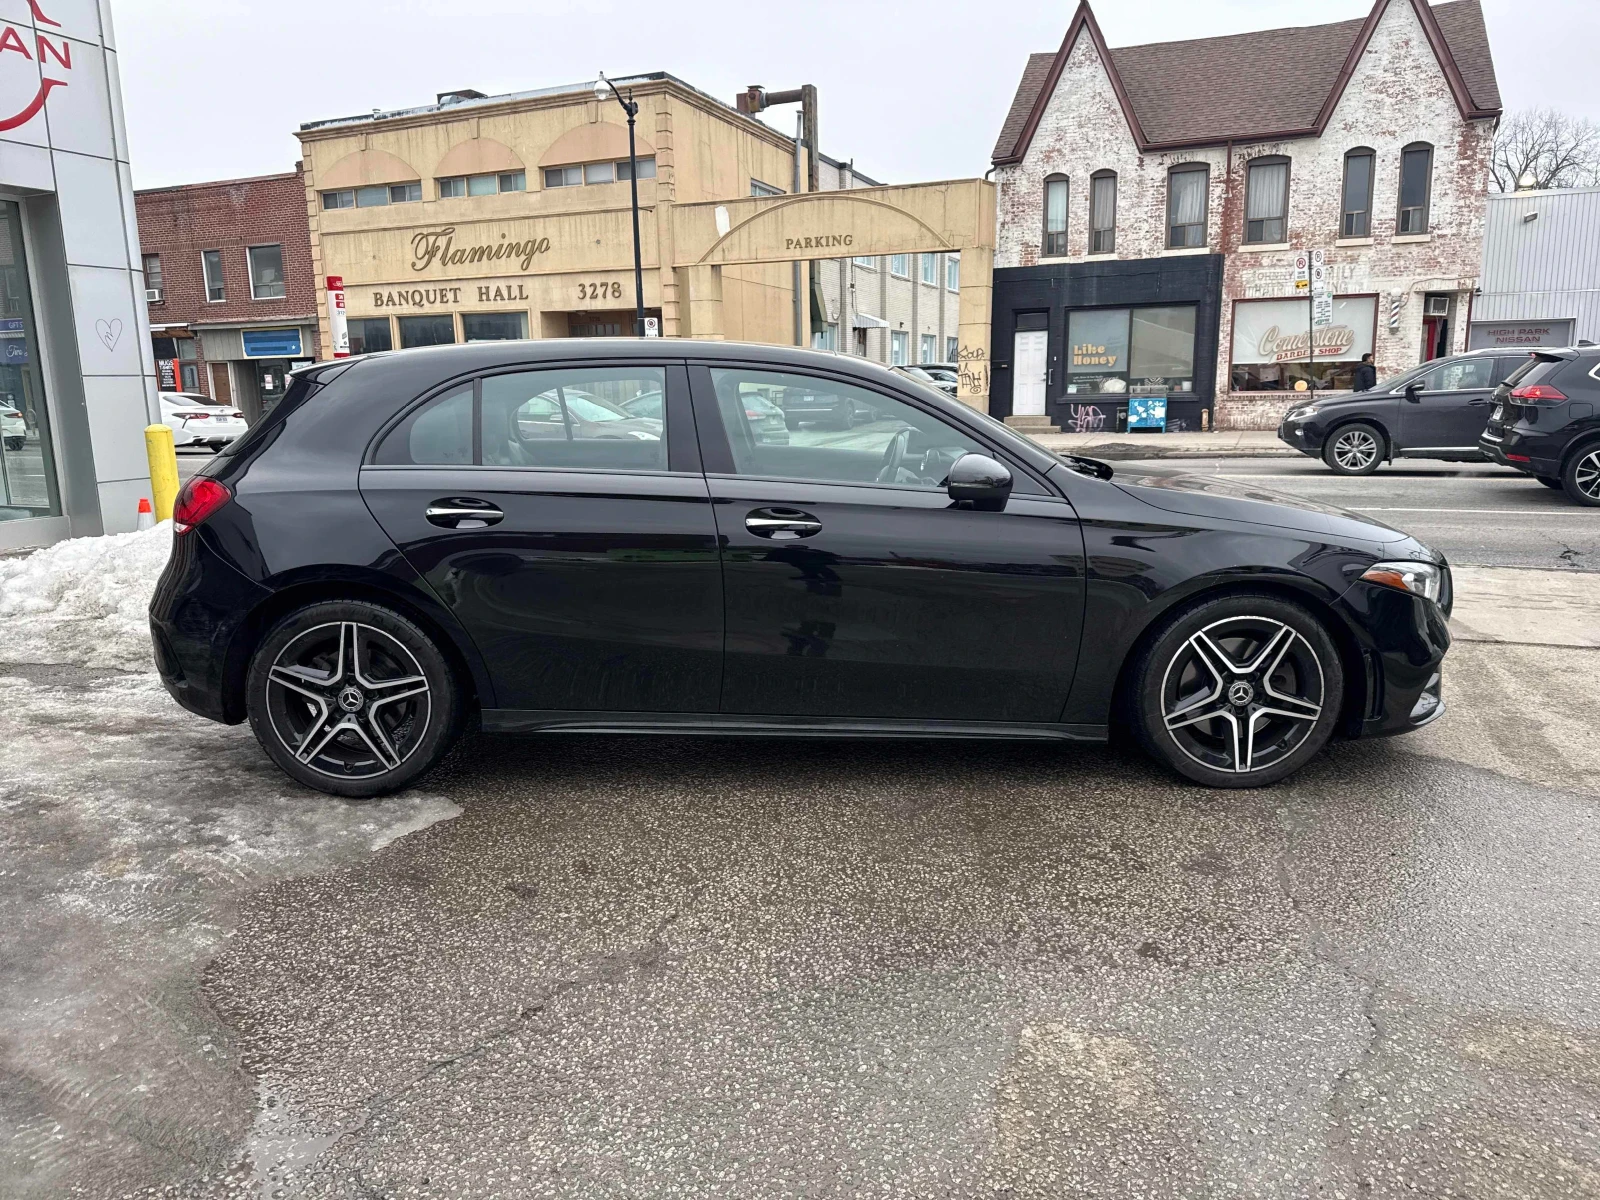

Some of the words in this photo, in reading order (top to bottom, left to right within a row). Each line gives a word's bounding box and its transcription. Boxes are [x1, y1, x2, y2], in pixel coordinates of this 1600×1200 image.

[785, 234, 853, 250] PARKING
[411, 227, 550, 271] Flamingo
[372, 287, 461, 308] BANQUET
[477, 284, 529, 302] HALL
[577, 281, 622, 300] 3278
[1518, 327, 1551, 336] PARK
[1496, 336, 1541, 344] NISSAN
[1073, 343, 1106, 355] Like
[1318, 347, 1342, 355] SHOP
[1073, 355, 1117, 367] Honey
